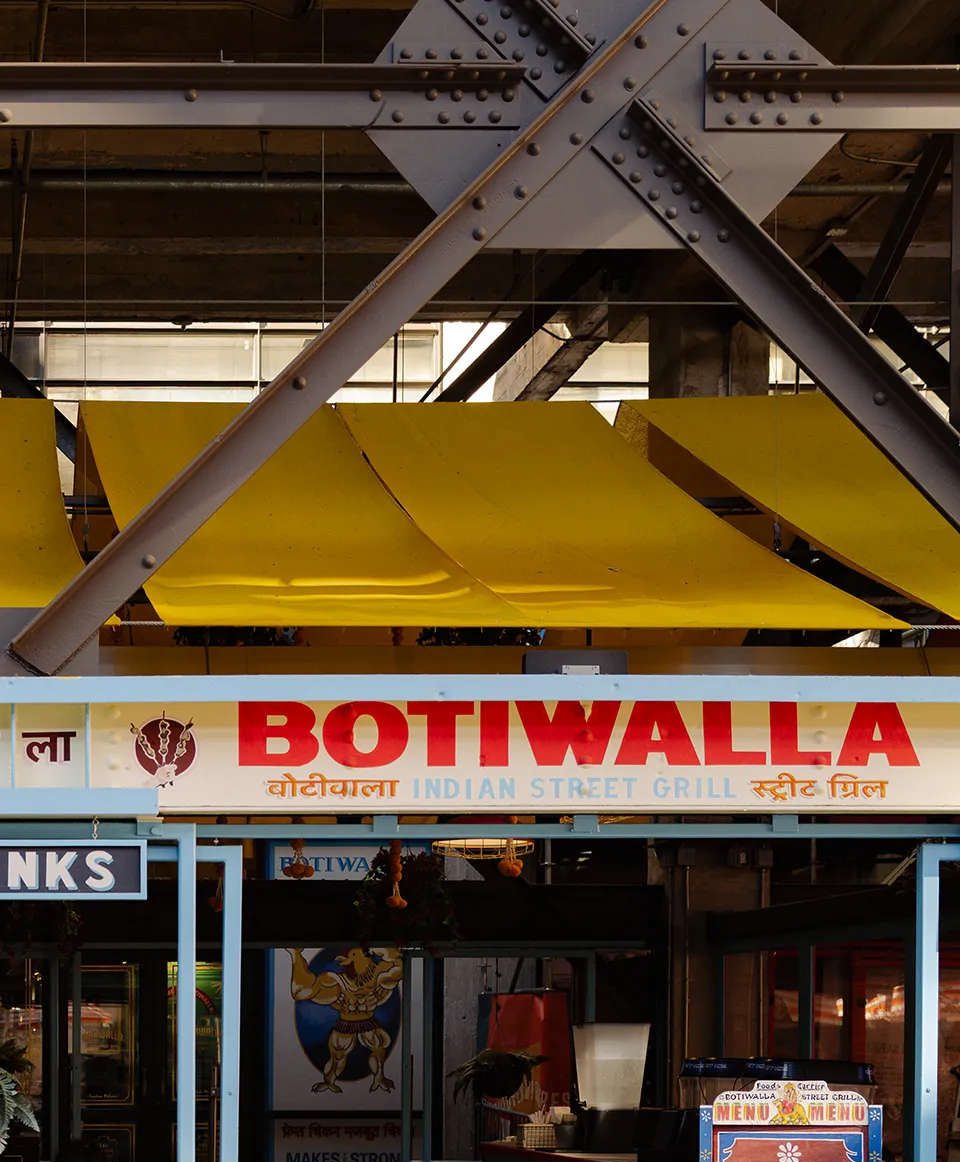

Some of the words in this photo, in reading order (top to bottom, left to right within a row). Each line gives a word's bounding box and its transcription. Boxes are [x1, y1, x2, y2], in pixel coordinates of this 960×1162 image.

[238, 701, 920, 767] BOTIWALLA
[21, 731, 76, 763] ला
[266, 773, 400, 798] बोटीवाला
[413, 777, 515, 799] INDIAN
[530, 777, 637, 799] STREET
[653, 777, 737, 799] GRILL
[725, 1092, 776, 1101] BOTIWALLA
[715, 1103, 770, 1121] MENU
[808, 1103, 865, 1121] MENU
